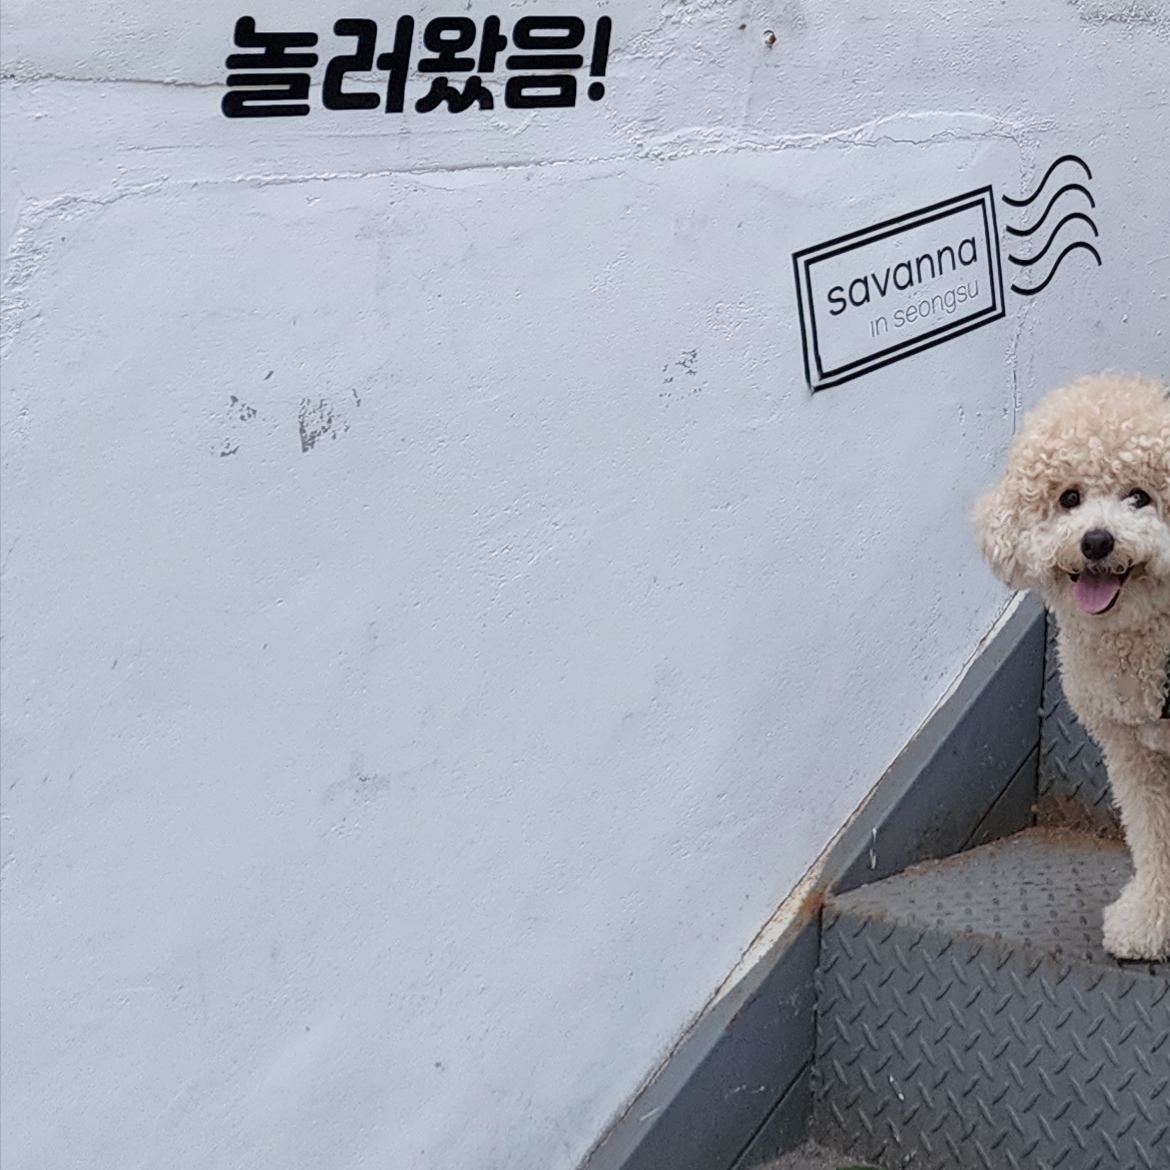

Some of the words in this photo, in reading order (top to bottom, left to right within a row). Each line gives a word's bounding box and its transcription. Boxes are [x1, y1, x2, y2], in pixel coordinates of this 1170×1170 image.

[221, 14, 613, 119] 놀러왔음!
[826, 236, 978, 317] savanna
[869, 314, 889, 339] in
[893, 279, 980, 331] seongsu
